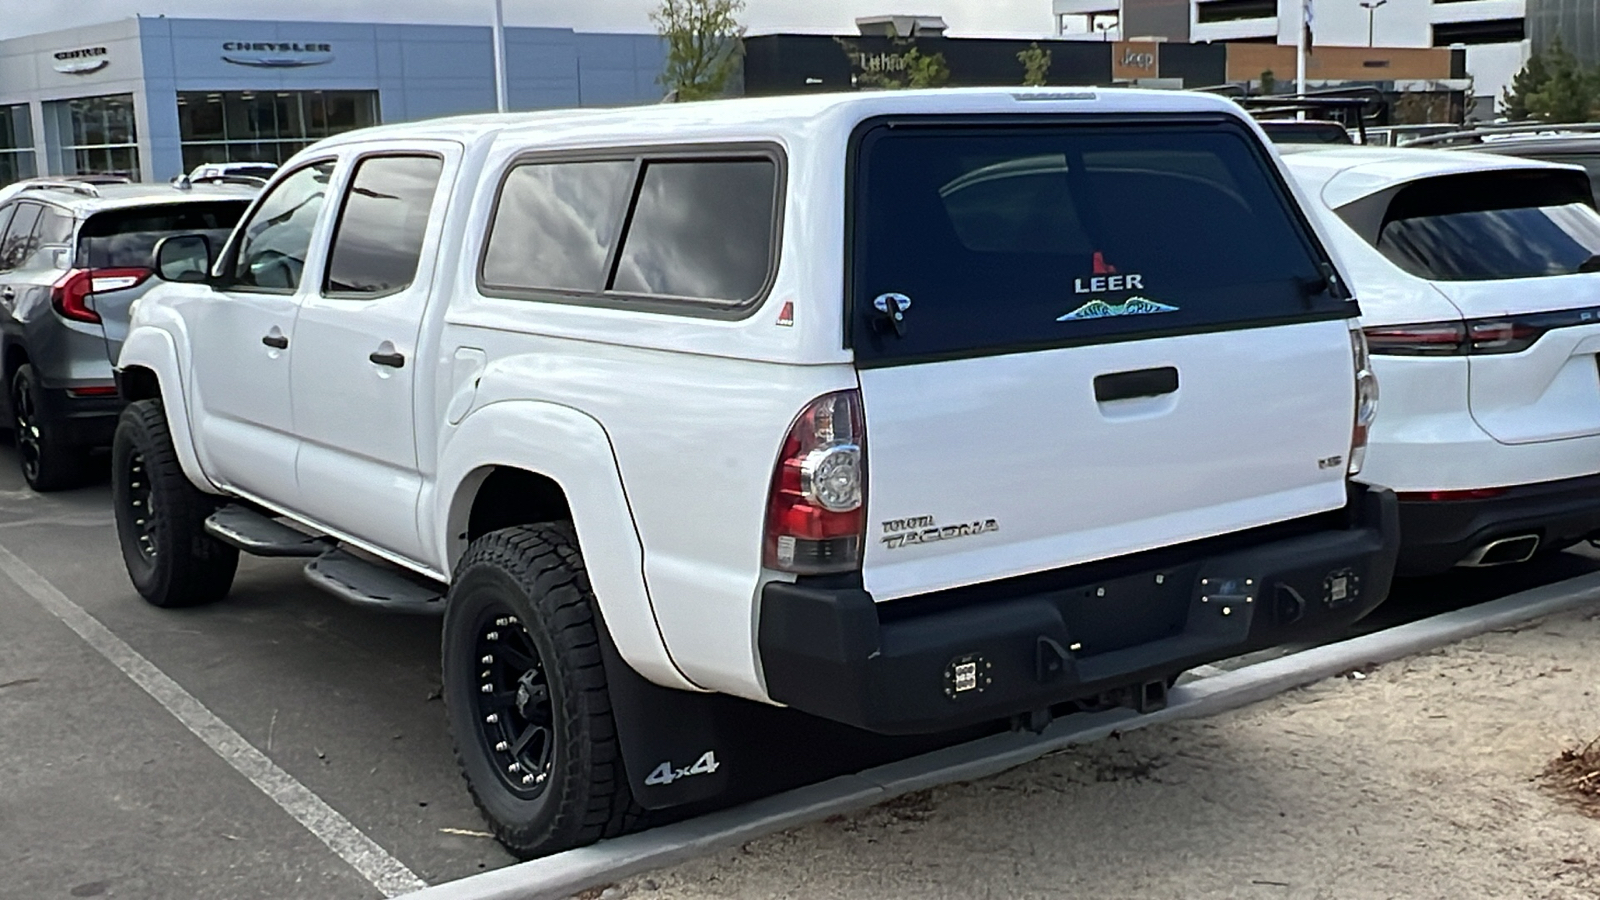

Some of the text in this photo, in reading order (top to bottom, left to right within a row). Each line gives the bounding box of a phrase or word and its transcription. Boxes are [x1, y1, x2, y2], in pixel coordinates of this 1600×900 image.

[222, 42, 332, 52] CHRYSLER
[1120, 48, 1154, 71] Jeep
[1074, 274, 1144, 293] LEER
[881, 518, 999, 549] TACOMA
[644, 750, 721, 786] 4x4
